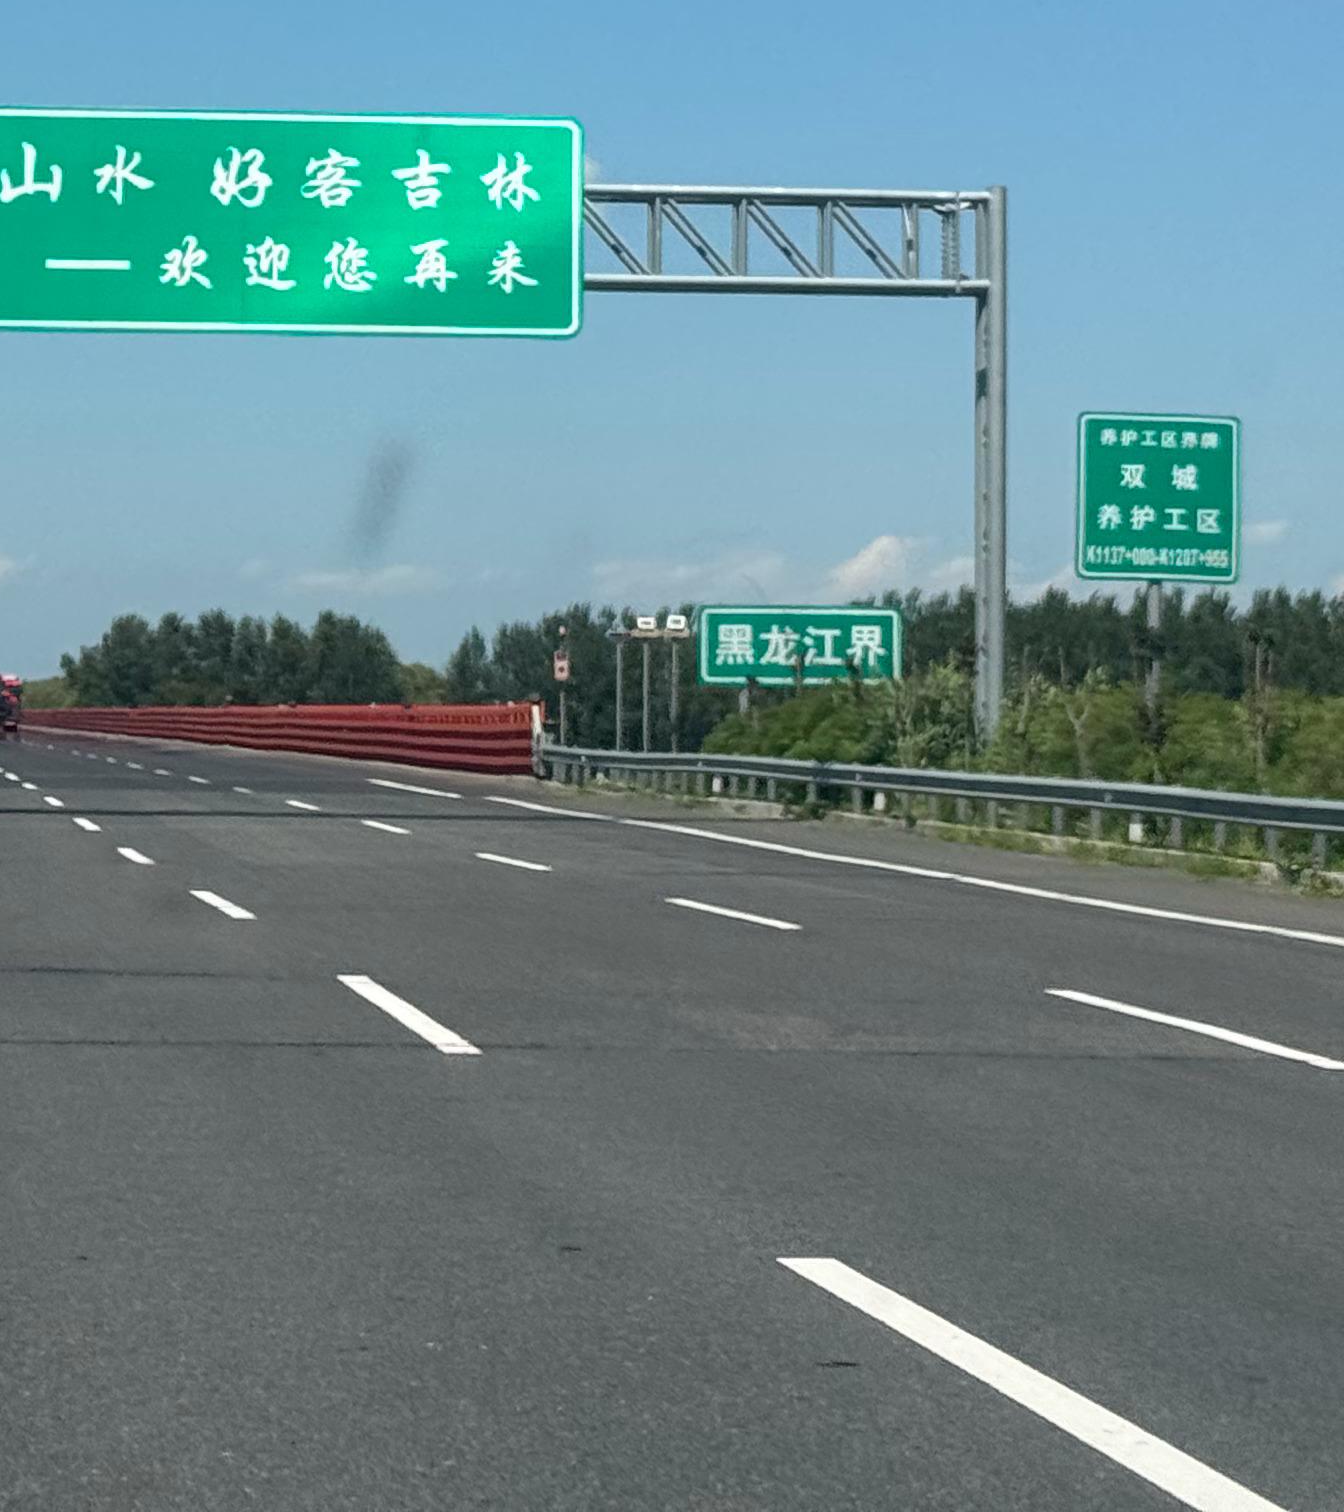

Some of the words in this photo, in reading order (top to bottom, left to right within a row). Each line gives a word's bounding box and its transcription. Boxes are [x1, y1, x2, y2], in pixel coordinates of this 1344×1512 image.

[210, 145, 541, 212] 好客吉林
[1097, 504, 1221, 533] 养护工区
[716, 624, 888, 666] 黑龙江界
